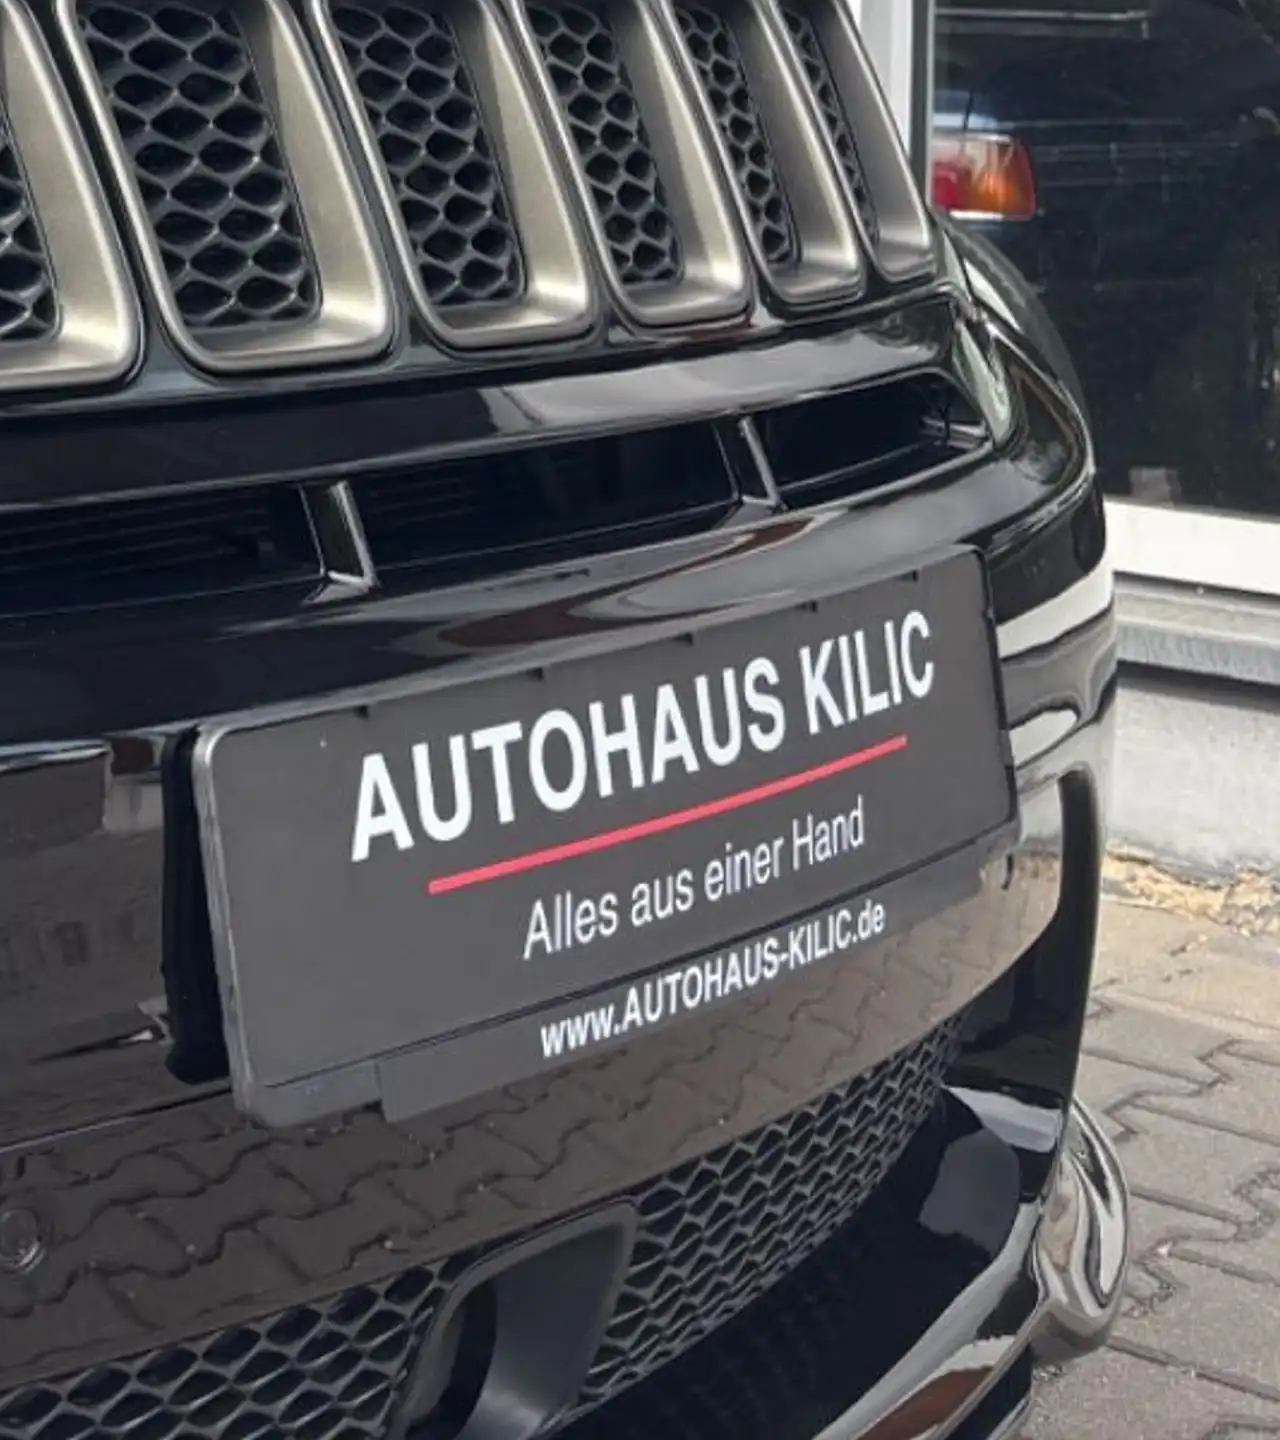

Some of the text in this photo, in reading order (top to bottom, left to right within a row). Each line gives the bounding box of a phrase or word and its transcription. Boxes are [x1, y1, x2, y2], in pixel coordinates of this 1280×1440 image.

[351, 610, 934, 861] AUTOHAUS KILIC
[523, 794, 865, 960] Alles aus einer Hand
[540, 899, 885, 1058] www.AUTOHAUS-KILIC.de
